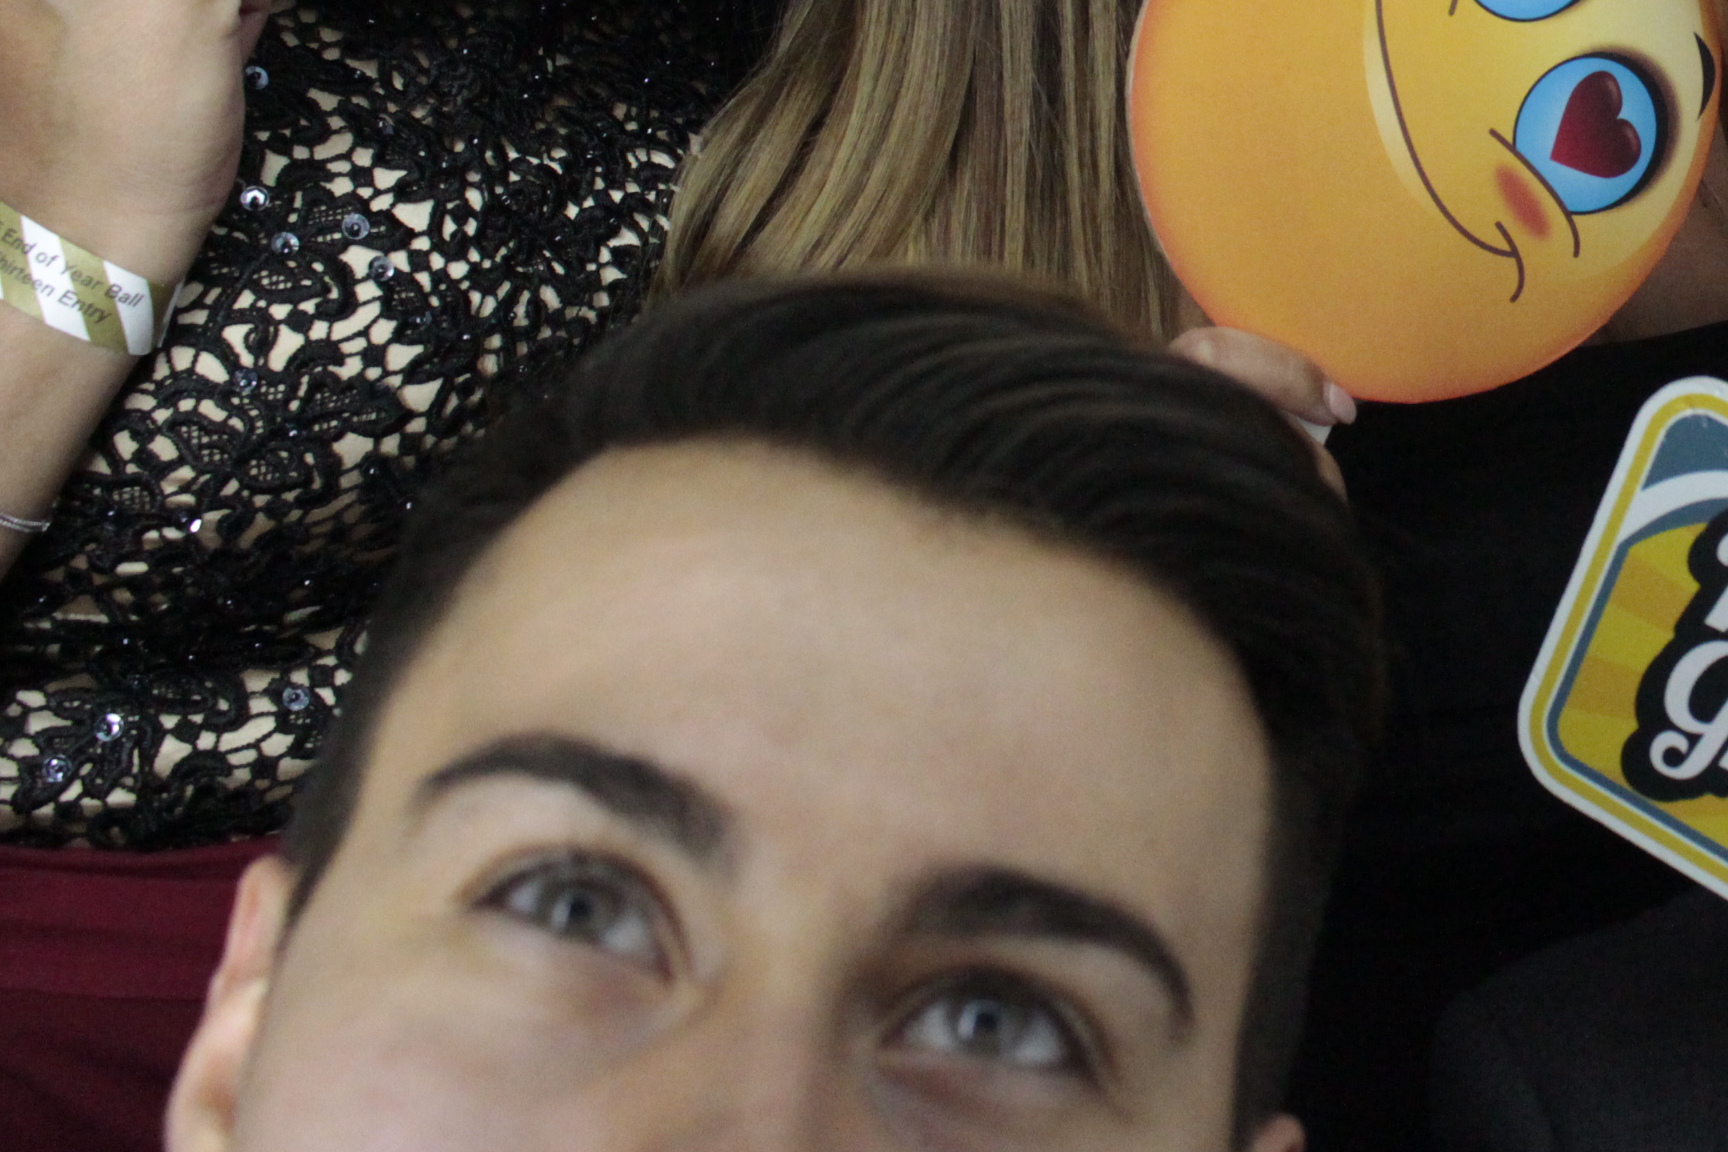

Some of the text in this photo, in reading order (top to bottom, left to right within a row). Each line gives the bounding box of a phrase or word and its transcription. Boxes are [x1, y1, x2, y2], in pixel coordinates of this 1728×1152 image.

[2, 228, 146, 308] End of Year Ball
[57, 289, 113, 325] Entry
